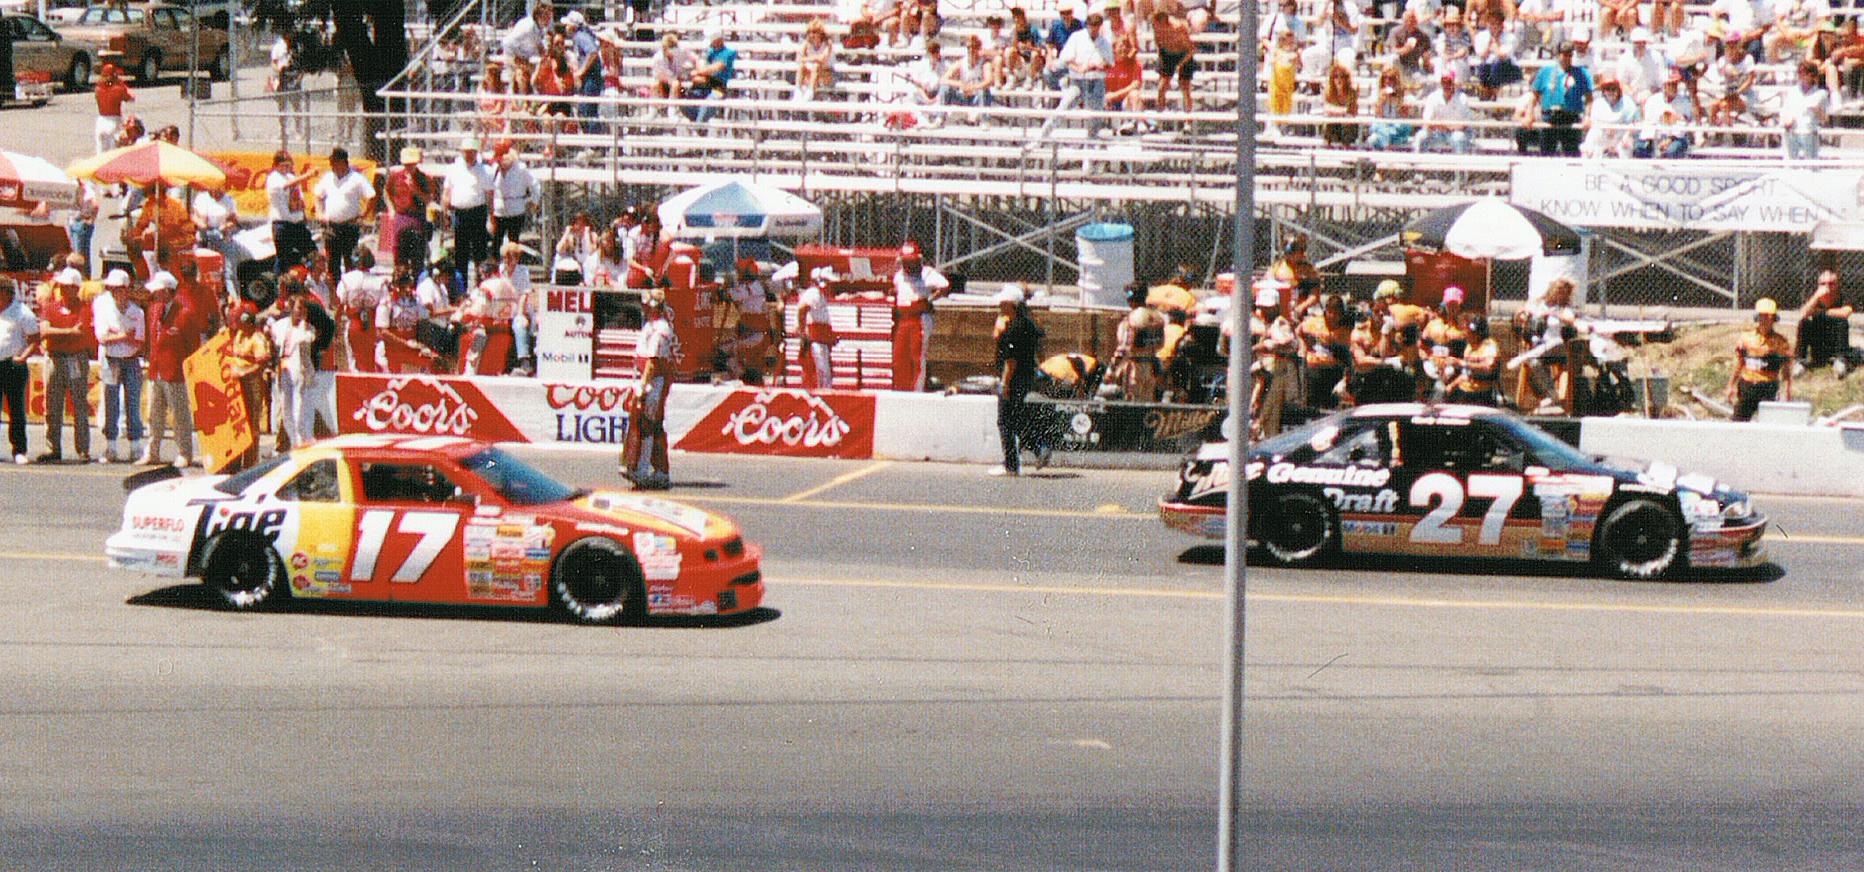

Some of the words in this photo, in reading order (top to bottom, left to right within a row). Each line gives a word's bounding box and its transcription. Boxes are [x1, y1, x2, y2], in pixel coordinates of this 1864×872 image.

[1585, 174, 1608, 191] BE
[1620, 174, 1633, 192] A
[1642, 175, 1700, 195] GOOD
[1711, 176, 1779, 196] SPORT
[1541, 200, 1599, 218] KNOW
[1611, 201, 1669, 220] WHEN
[1681, 203, 1705, 221] TO
[1713, 205, 1749, 222] SAY
[1760, 205, 1819, 223] WHEN
[542, 352, 575, 363] Mobil
[364, 389, 473, 436] Coors
[730, 403, 843, 447] Coors
[1143, 409, 1218, 441] Miller
[555, 413, 630, 444] LIGH
[1267, 461, 1391, 487] Genuine
[1323, 486, 1400, 513] Draft
[1408, 472, 1525, 546] 27
[132, 516, 185, 532] SUPERFLO
[185, 494, 288, 577] Tide
[350, 510, 460, 585] 17
